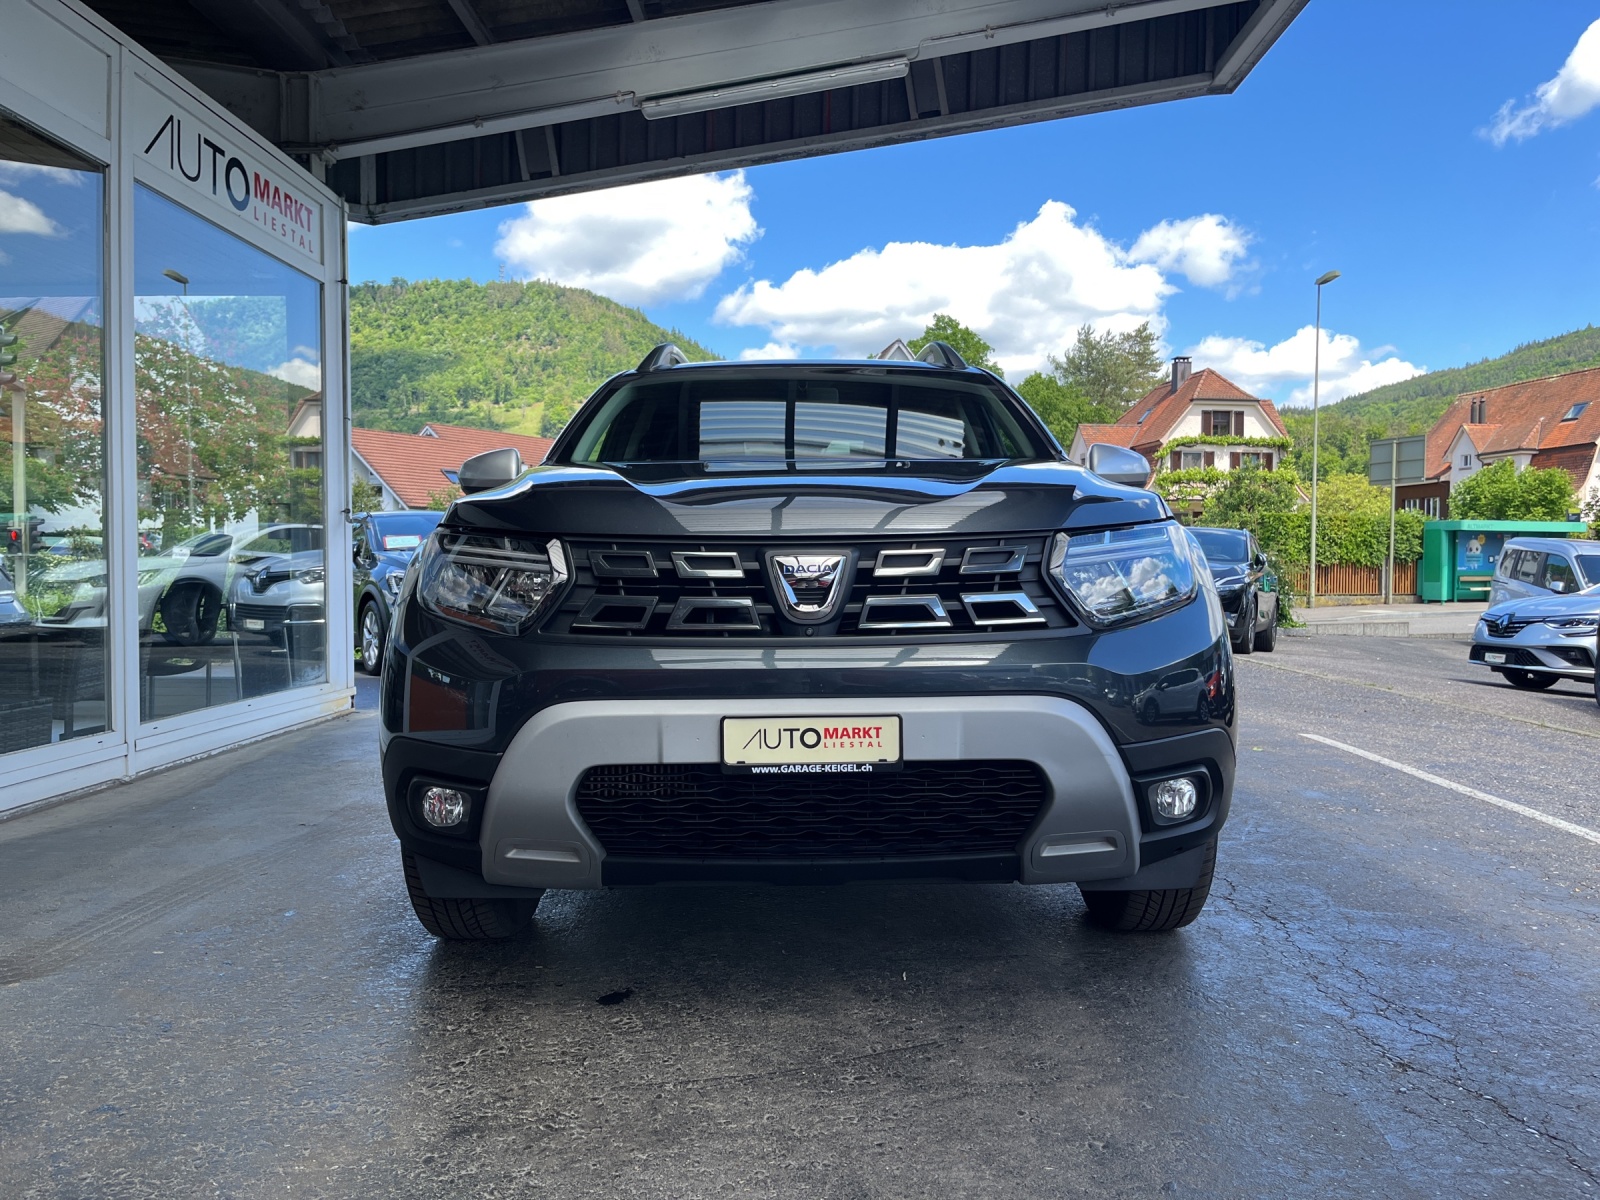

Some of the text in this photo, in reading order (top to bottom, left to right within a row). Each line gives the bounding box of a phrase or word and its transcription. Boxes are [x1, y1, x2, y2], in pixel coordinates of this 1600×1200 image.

[144, 114, 313, 232] AUTO MARKT
[253, 206, 314, 254] LIESTAL
[783, 564, 833, 574] DACIA
[743, 727, 882, 749] AUTO MARKT
[751, 764, 873, 773] www.GARAGE-KEIGEL.ch
